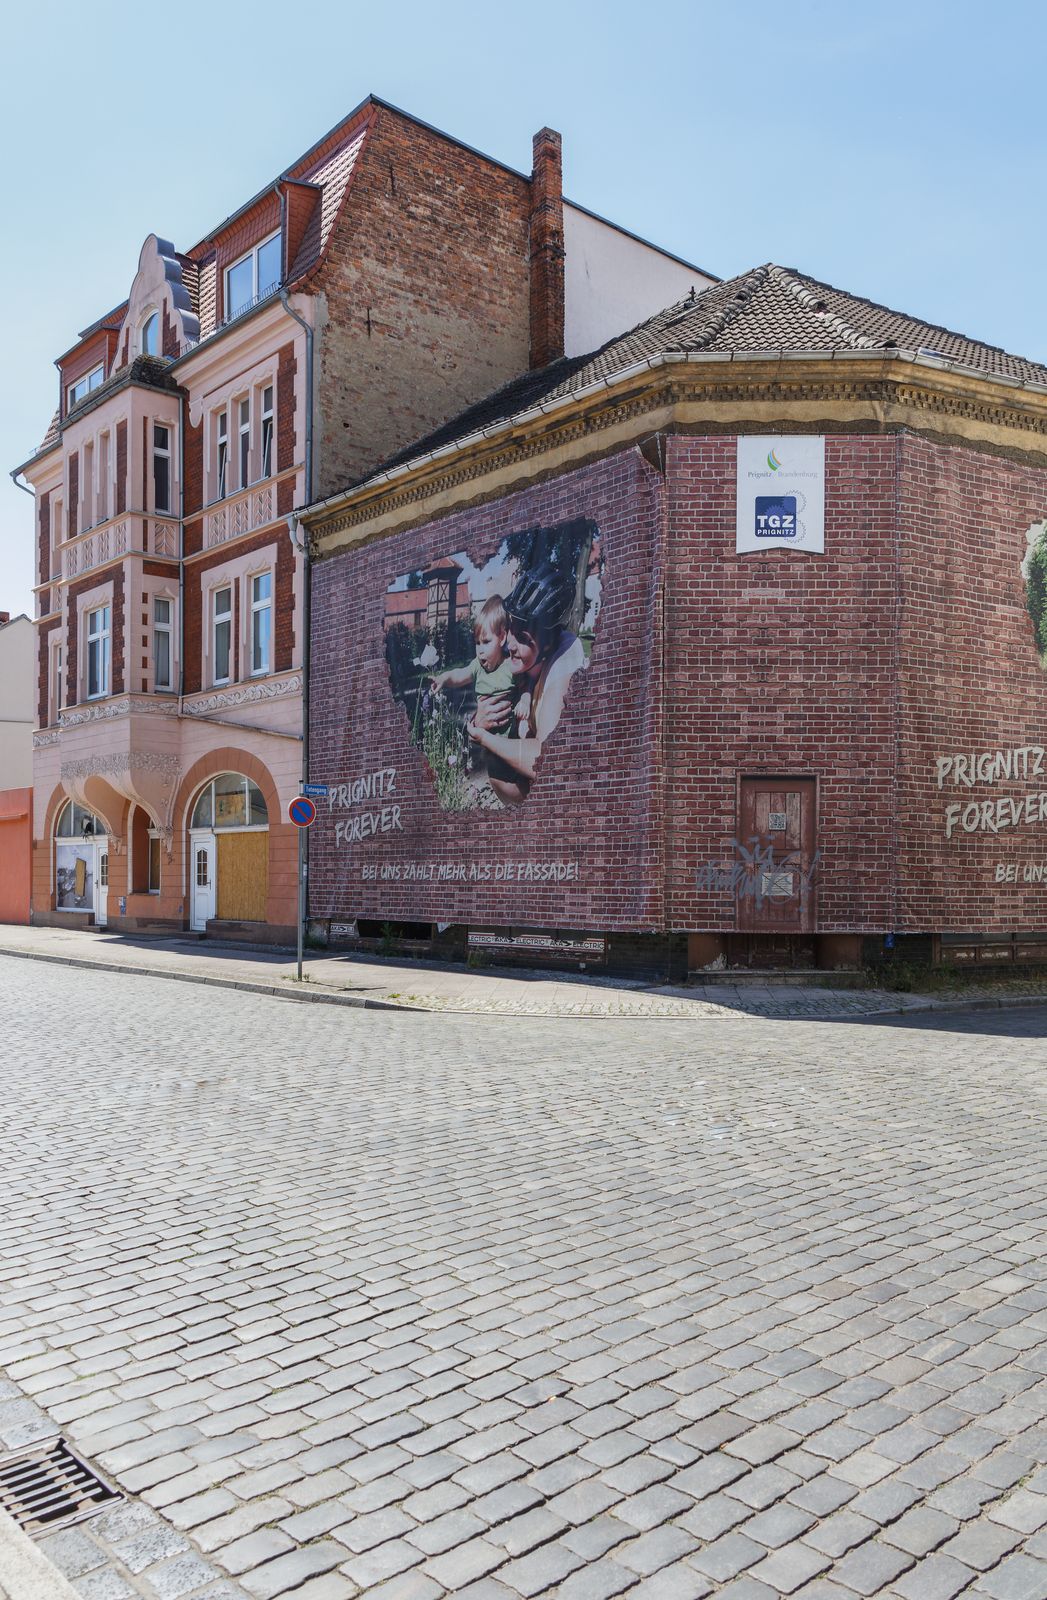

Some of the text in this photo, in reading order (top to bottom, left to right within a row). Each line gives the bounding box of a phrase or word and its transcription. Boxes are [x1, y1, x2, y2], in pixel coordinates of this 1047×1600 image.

[757, 515, 794, 528] TGZ
[935, 746, 1046, 790] PRIGNITZ
[328, 768, 396, 812] PRIGNITZ
[335, 805, 404, 848] FOREVER
[362, 860, 579, 882] BEI UNS ZÄHLT MEHR ALS DIE FASSADE!
[995, 863, 1019, 883] BEI
[516, 937, 545, 945] ELECTRIC
[572, 941, 605, 949] ELECTRIC
